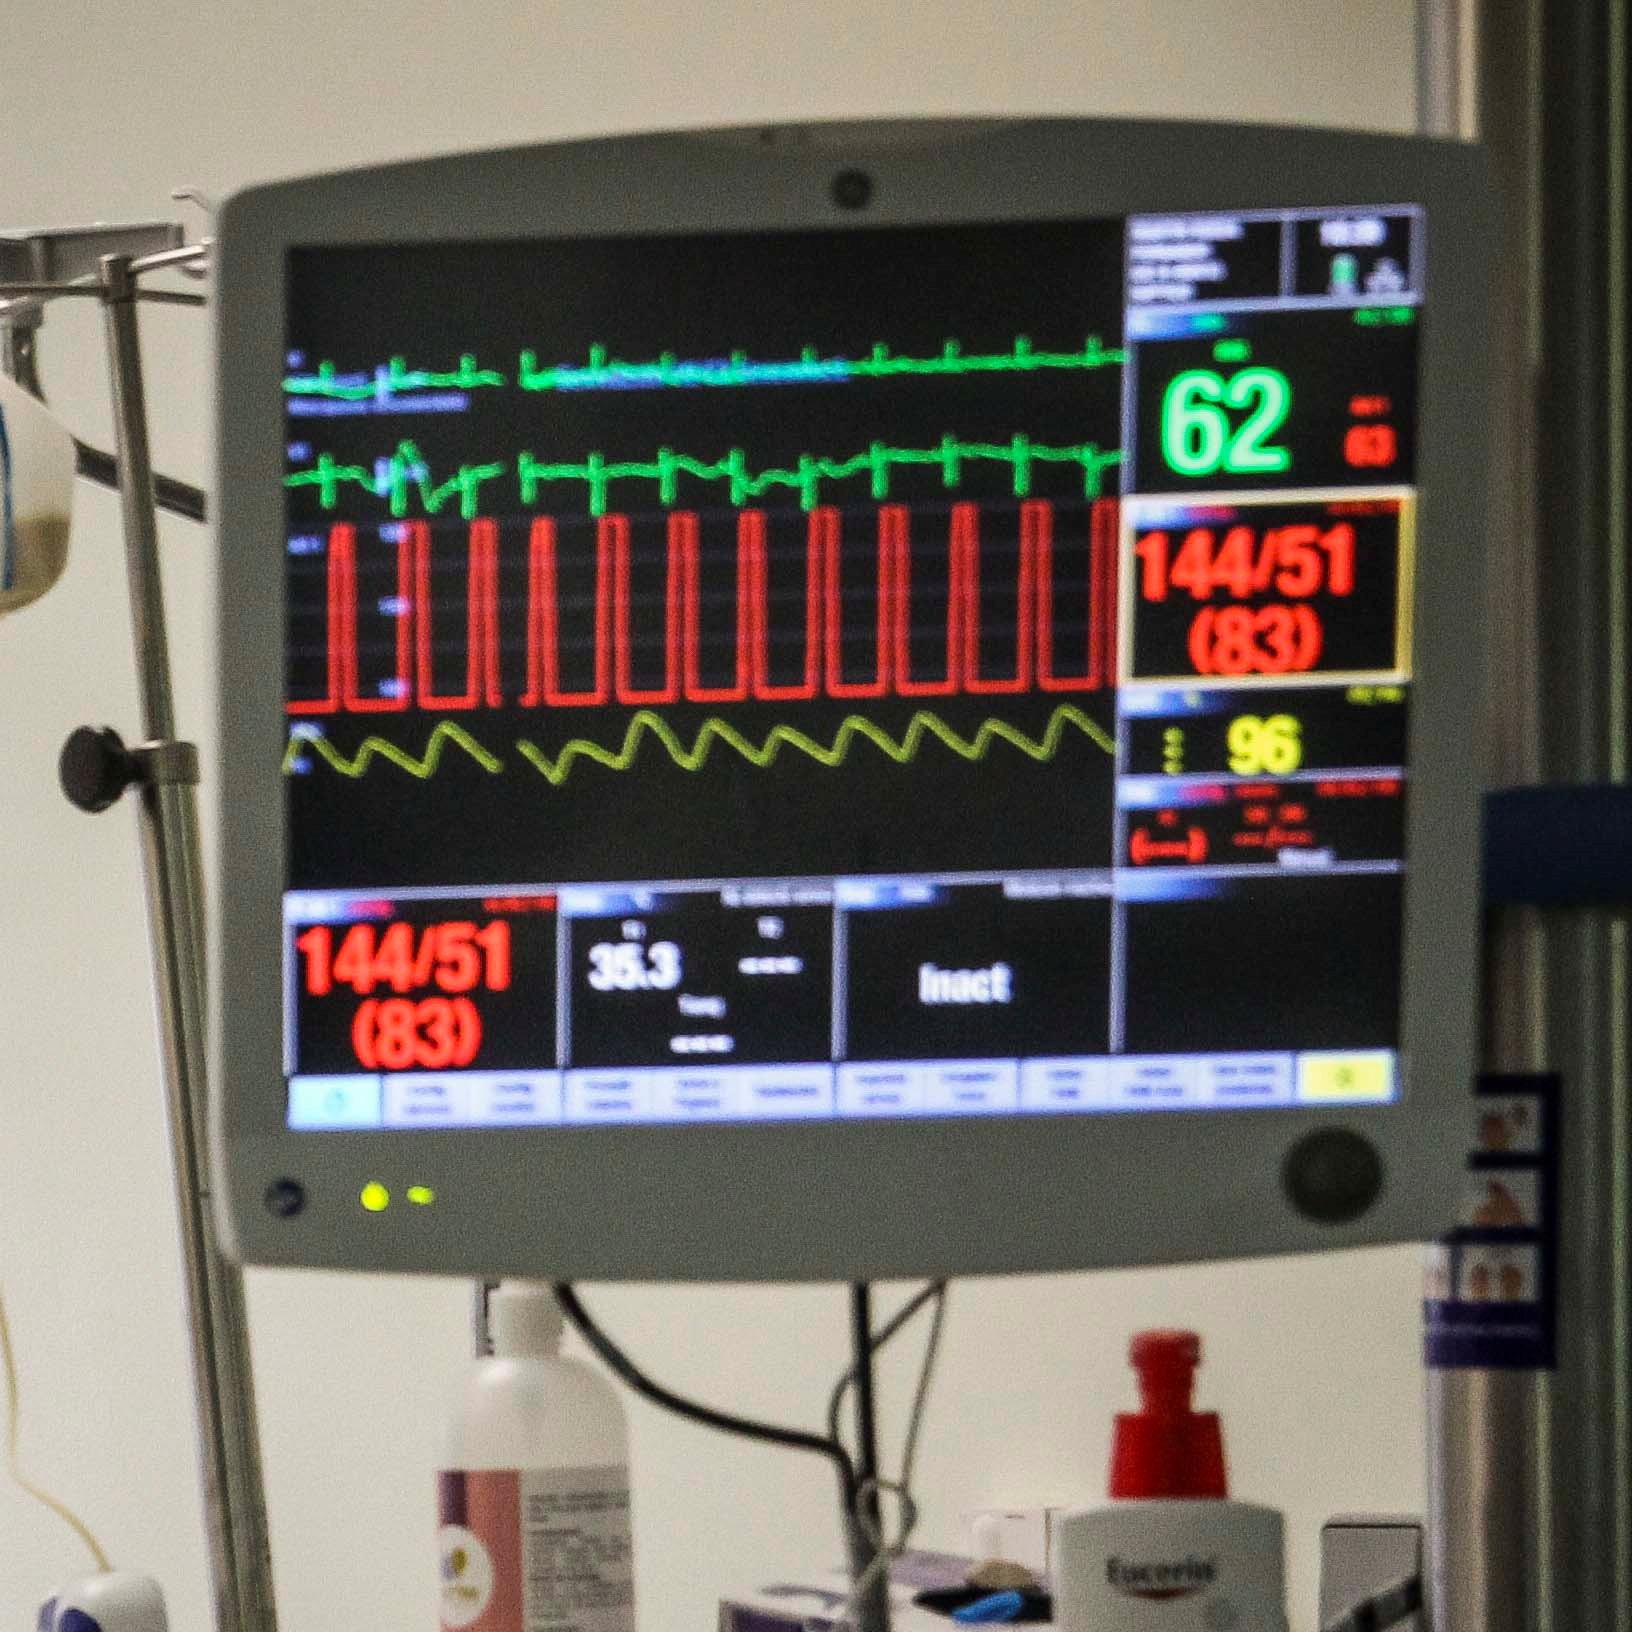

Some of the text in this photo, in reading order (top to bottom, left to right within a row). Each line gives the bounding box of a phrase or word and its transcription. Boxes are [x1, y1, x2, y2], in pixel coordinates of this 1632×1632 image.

[1160, 366, 1292, 477] 62
[1135, 521, 1358, 603] 144/51
[1187, 603, 1324, 676] (83)
[1226, 712, 1303, 777] 96
[296, 918, 513, 997] 144/51
[587, 940, 683, 993] 35.3
[917, 961, 1013, 1006] Inact
[351, 995, 485, 1071] (83)
